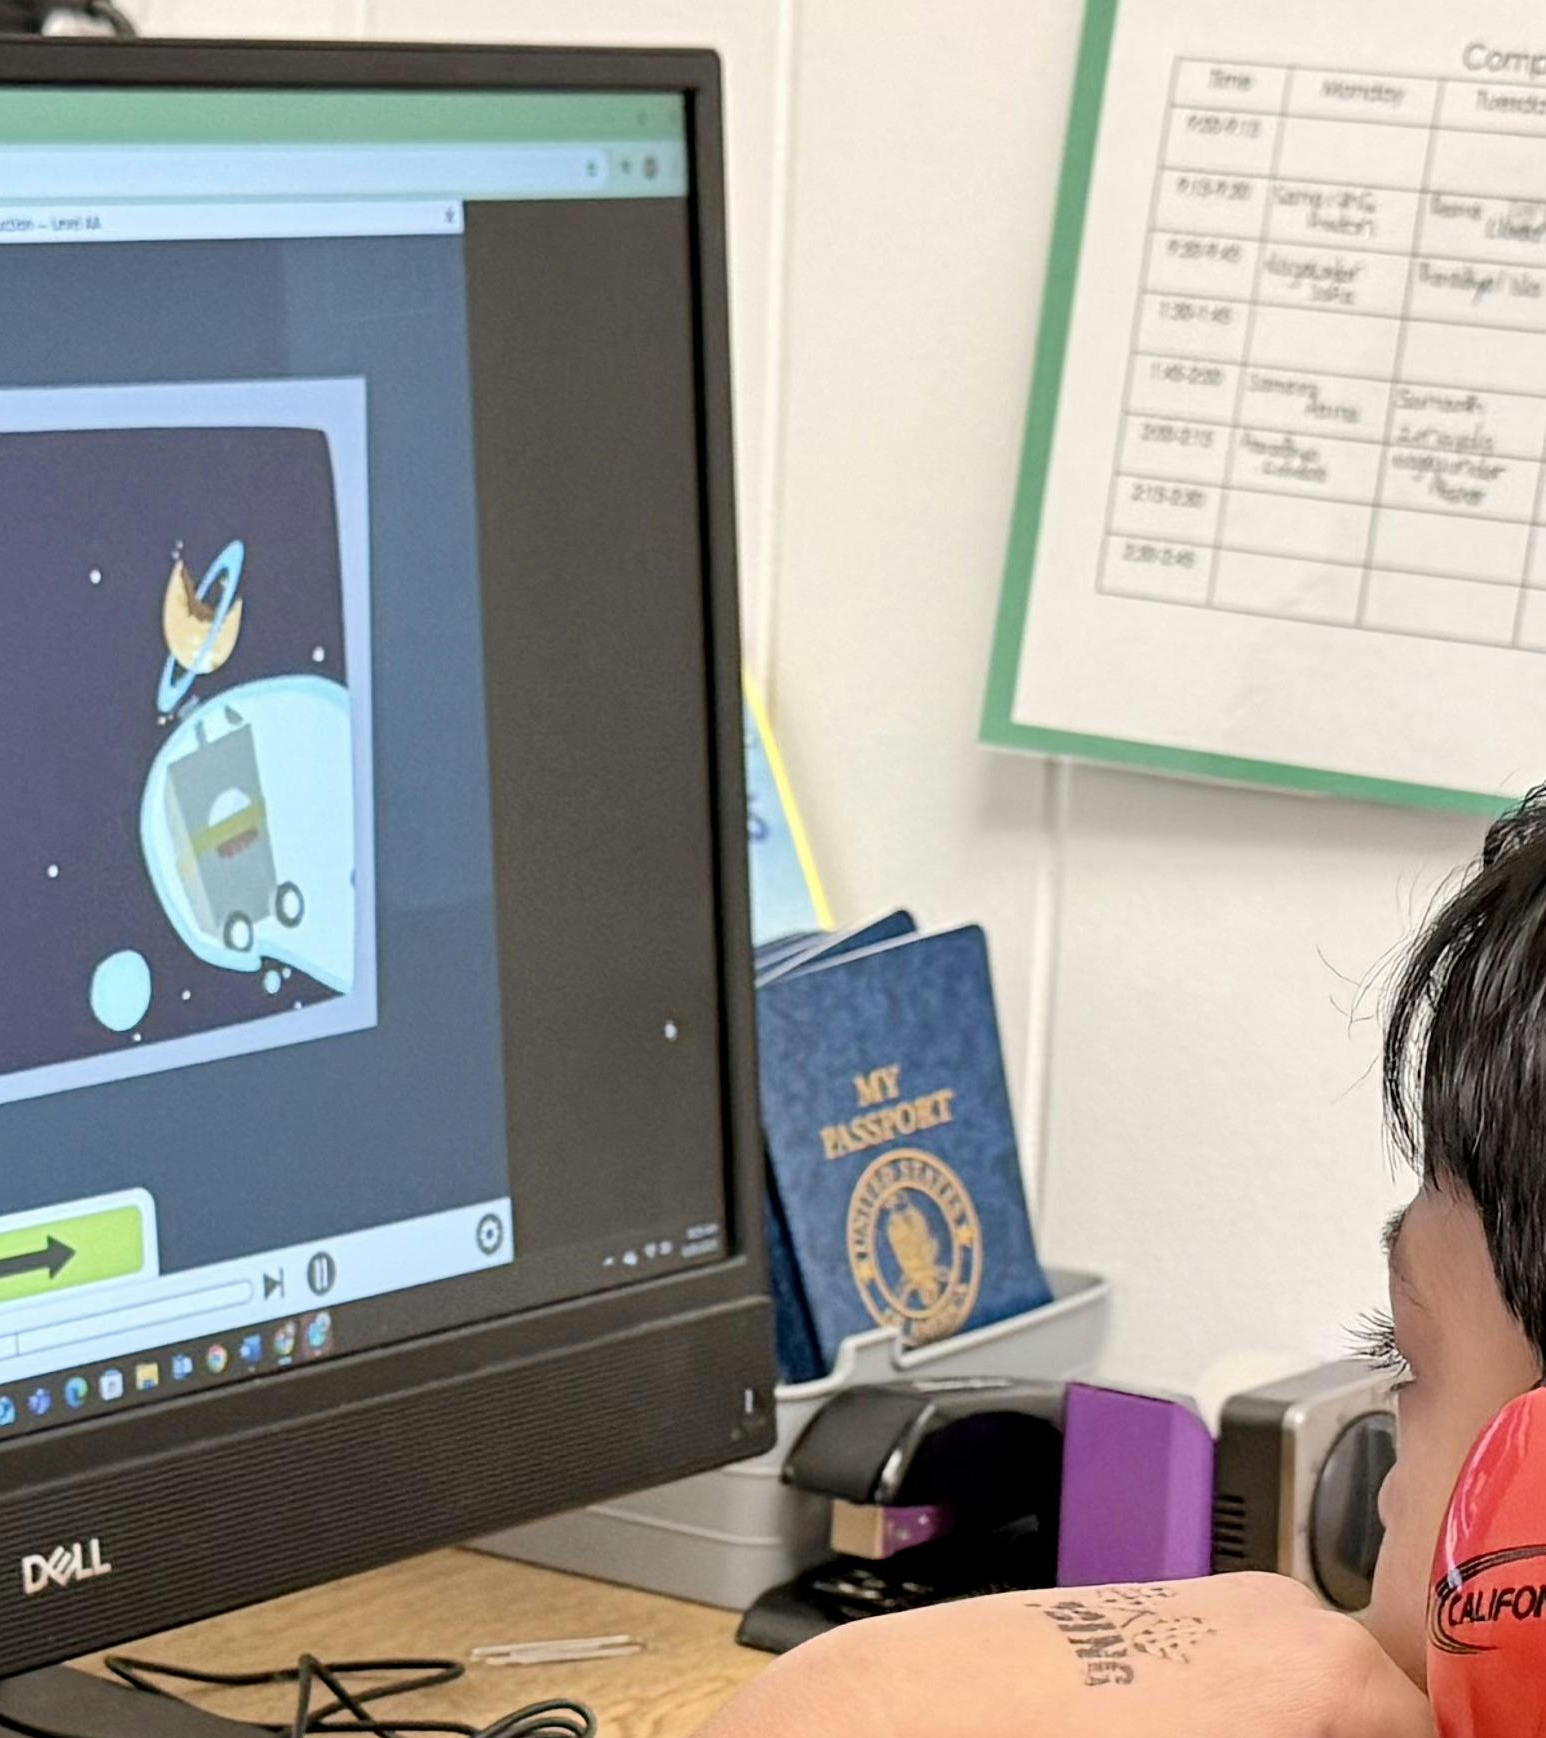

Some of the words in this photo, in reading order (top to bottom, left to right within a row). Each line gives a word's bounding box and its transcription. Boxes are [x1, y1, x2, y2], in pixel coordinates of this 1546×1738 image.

[854, 1065, 901, 1106] MY
[819, 1088, 955, 1160] PASSPORT
[22, 1538, 112, 1595] DELL
